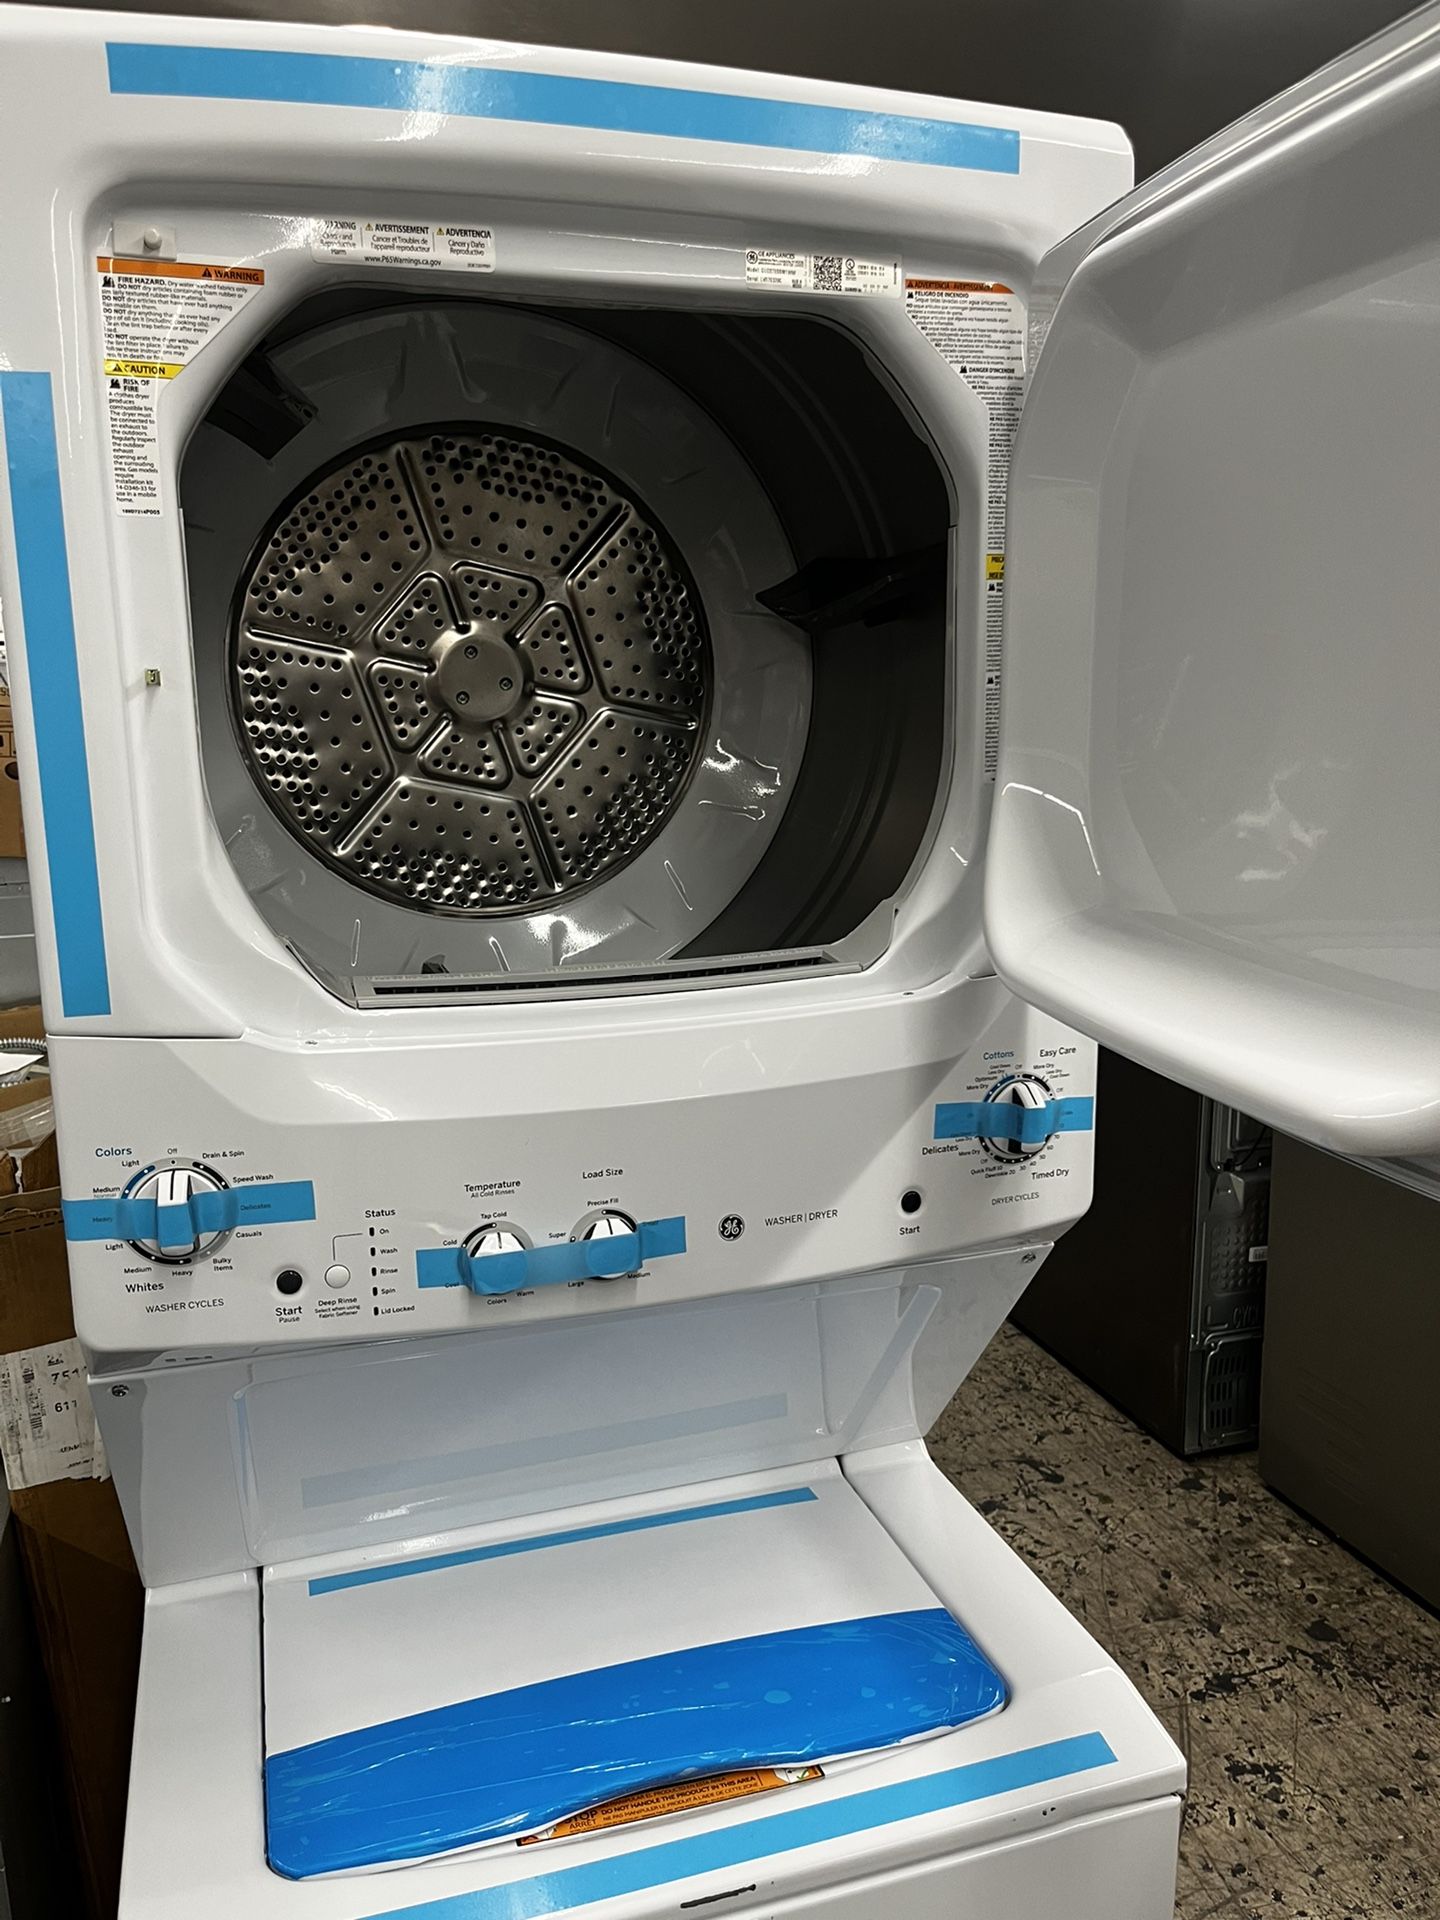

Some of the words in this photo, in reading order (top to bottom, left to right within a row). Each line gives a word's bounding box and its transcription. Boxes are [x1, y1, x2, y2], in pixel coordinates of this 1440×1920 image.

[375, 224, 429, 235] AVERTISSEMENT
[446, 228, 491, 239] ADVERTENCIA
[364, 256, 441, 267] www.P65Warnings.ca.gov
[214, 270, 259, 281] WARNING
[125, 365, 166, 375] CAUTION
[983, 1051, 1014, 1060] Cottons
[1040, 1049, 1057, 1058] Easy
[1059, 1047, 1076, 1055] Care
[95, 1147, 132, 1157] Colors
[922, 1145, 959, 1155] Delicates
[583, 1170, 603, 1179] Load
[605, 1168, 624, 1177] Size
[1032, 1170, 1054, 1180] Timed
[1056, 1168, 1069, 1177] Dry
[464, 1180, 521, 1192] Temperature
[587, 1199, 608, 1207] Precise
[991, 1196, 1014, 1206] DRYER
[1015, 1192, 1039, 1202] CYCLES
[365, 1209, 396, 1219] Status
[764, 1214, 803, 1226] WASHER
[809, 1209, 838, 1221] DRYER
[548, 1231, 567, 1239] Super
[899, 1225, 920, 1235] Start
[105, 1243, 124, 1251] Light
[124, 1266, 152, 1274] Medium
[125, 1282, 164, 1293] Whites
[145, 1302, 186, 1313] WASHER
[188, 1299, 224, 1309] CYCLES
[275, 1306, 302, 1317] Start
[392, 1305, 415, 1313] Locked
[631, 1798, 660, 1808] HANDLE
[677, 1786, 710, 1798] PRODUCT
[737, 1776, 757, 1785] AREA
[570, 1818, 596, 1829] ARRÊT
